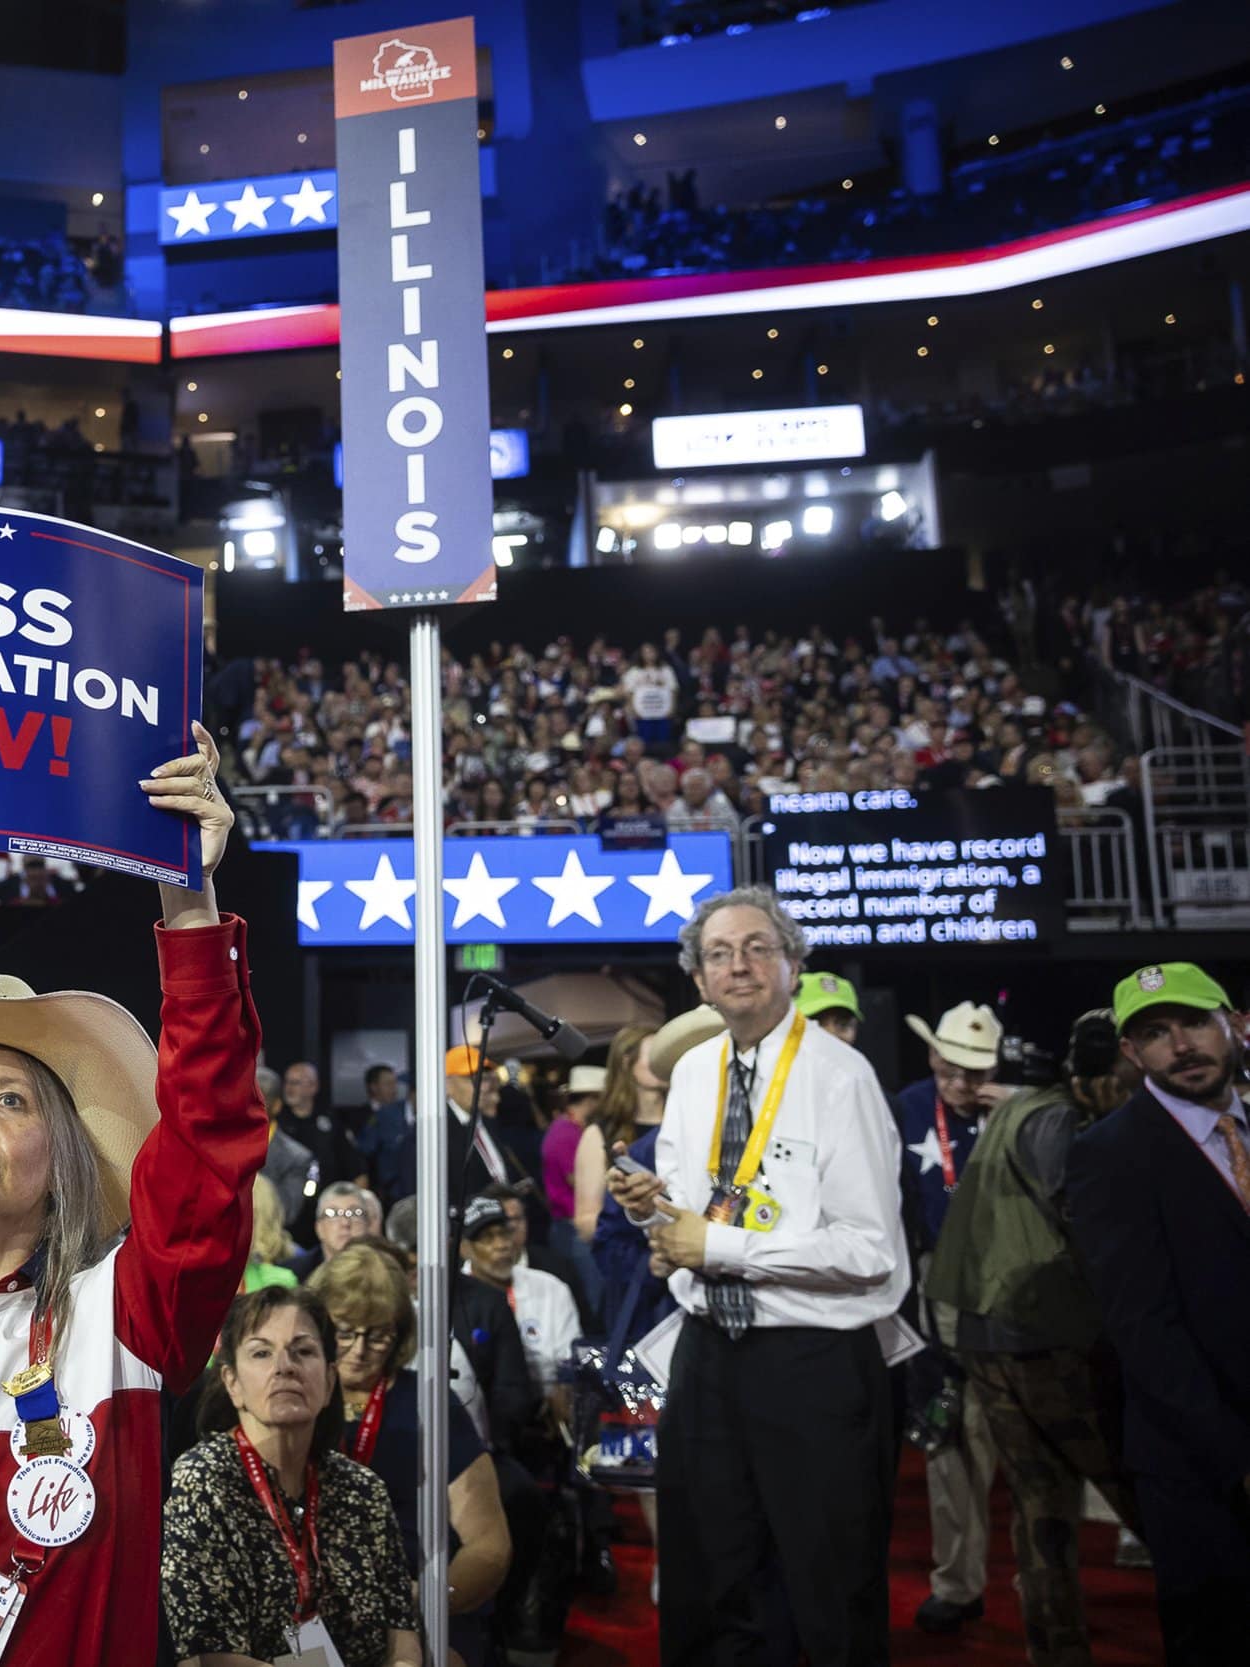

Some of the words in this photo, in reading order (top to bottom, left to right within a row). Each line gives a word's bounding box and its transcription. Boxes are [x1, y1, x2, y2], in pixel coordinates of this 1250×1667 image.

[359, 65, 452, 92] MILWAUKEE
[386, 127, 444, 564] ILLINOIS
[853, 789, 918, 811] care.
[788, 842, 845, 866] Now
[848, 843, 888, 864] we
[891, 837, 957, 862] have
[961, 832, 1046, 860] record
[775, 867, 851, 896] illegal
[855, 862, 1017, 893] immigration,
[1022, 864, 1042, 886] a
[778, 893, 859, 919] record
[863, 891, 965, 917] number
[968, 888, 998, 914] of
[803, 924, 872, 946] omen
[876, 917, 926, 943] and
[931, 916, 1037, 942] children
[77, 1452, 88, 1464] are
[85, 1423, 94, 1452] Pro-Life
[16, 1467, 31, 1481] The
[32, 1458, 52, 1469] First
[54, 1458, 87, 1483] Freedom
[27, 1472, 79, 1532] Life
[12, 1508, 51, 1544] Republicans
[53, 1536, 67, 1544] are
[69, 1510, 92, 1539] Pro-Life
